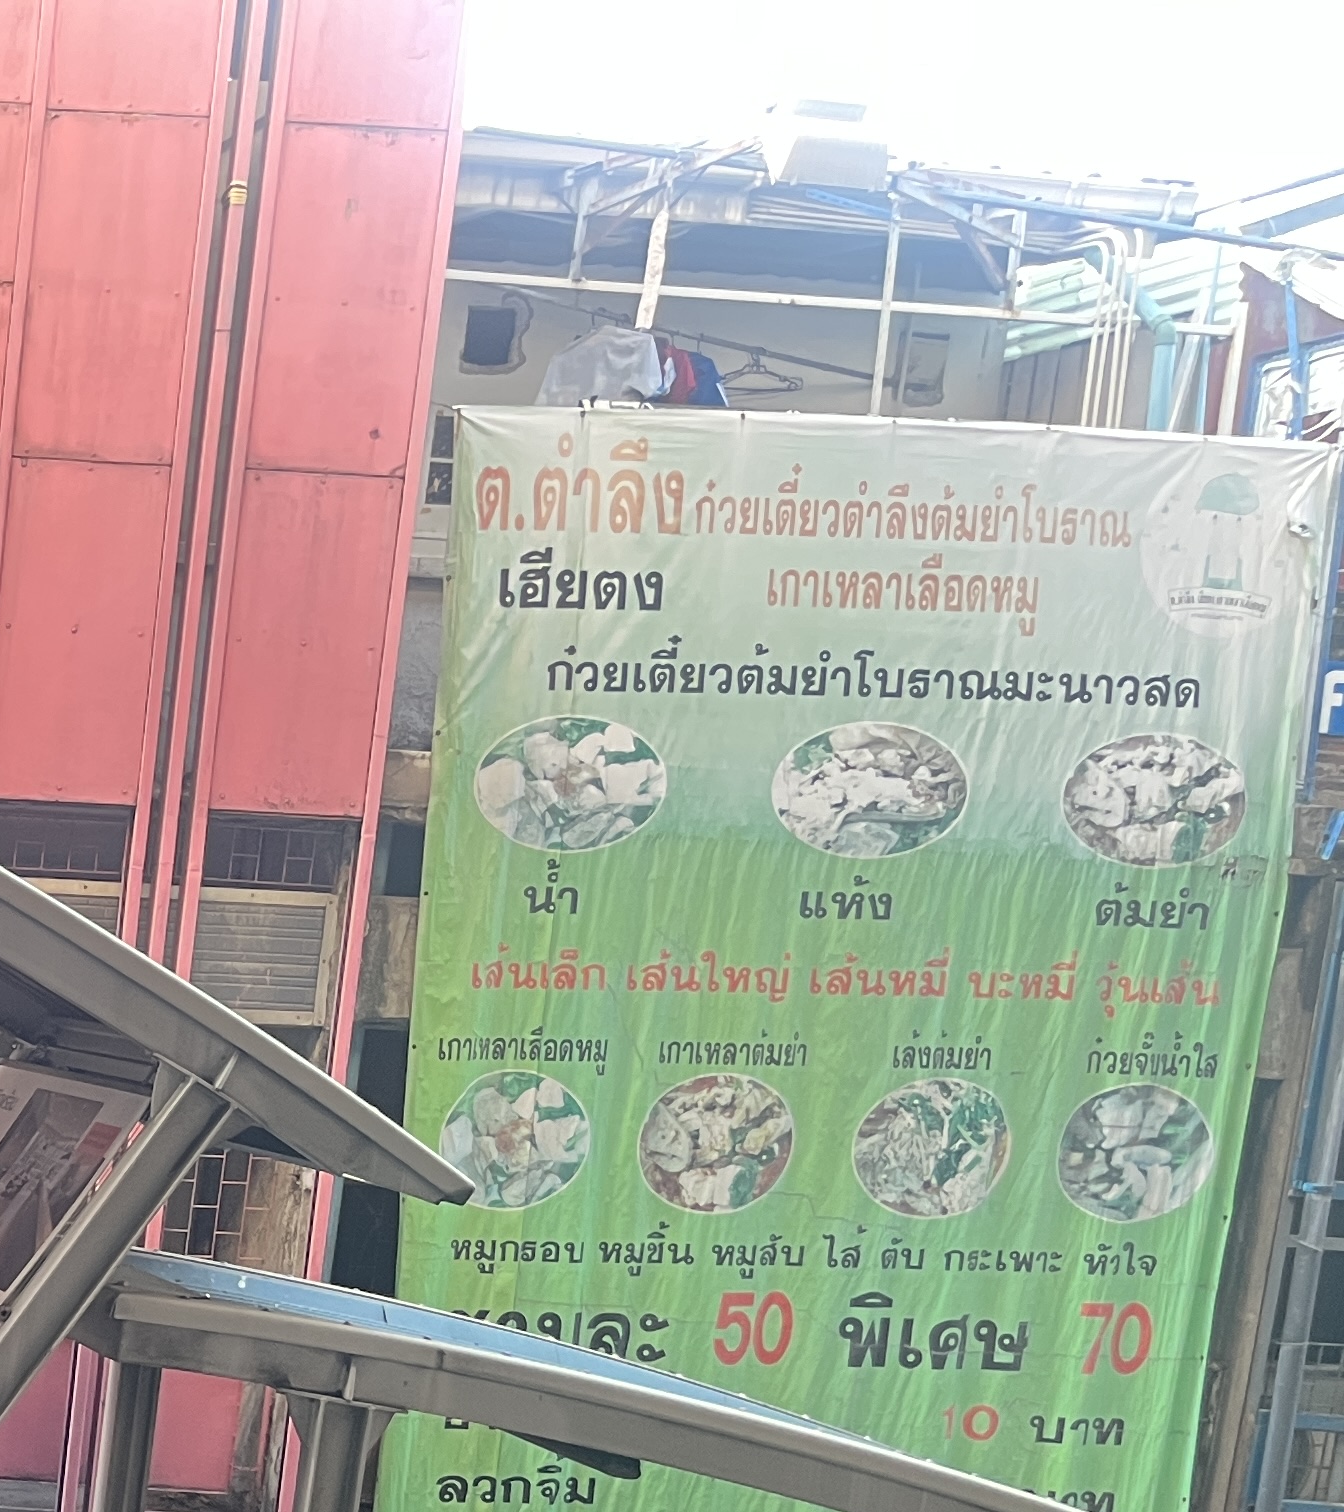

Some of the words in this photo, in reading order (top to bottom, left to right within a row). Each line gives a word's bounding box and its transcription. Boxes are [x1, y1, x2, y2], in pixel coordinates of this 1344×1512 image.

[499, 547, 665, 611] เฮียตง
[767, 553, 1039, 637] เกาเหลาเลือดหมู
[547, 635, 1201, 709] ก๋วยเตี๋ยวต้มยำโบราณมะนาวสด
[523, 858, 579, 915] น้ำ
[798, 875, 893, 921] แห้ง
[1095, 882, 1210, 931] ต้มยำ
[471, 942, 608, 991] เส้นเล็ก
[627, 950, 790, 1004] เส้นใหญ่
[810, 947, 951, 998] เส้นหมี่
[968, 951, 1078, 1001] บะหมี่
[1096, 959, 1222, 1018] วุ้นเส้น
[658, 1032, 809, 1067] เกาเหลาต้มยำ
[893, 1030, 992, 1071] เล้งต้มยำ
[451, 1236, 585, 1275] หมูกรอบ
[598, 1222, 695, 1277] หมูชิ้น
[712, 1234, 805, 1279] หมูสับ
[823, 1225, 868, 1270] ไส้
[880, 1239, 925, 1271] ตับ
[944, 1247, 1063, 1275] กระเพาะ
[1083, 1242, 1158, 1277] หัวใจ
[713, 1290, 794, 1366] 50
[839, 1291, 1029, 1371] พิเศษ
[1080, 1302, 1154, 1376] 70
[942, 1404, 1000, 1442] 10
[1029, 1414, 1125, 1446] บาท
